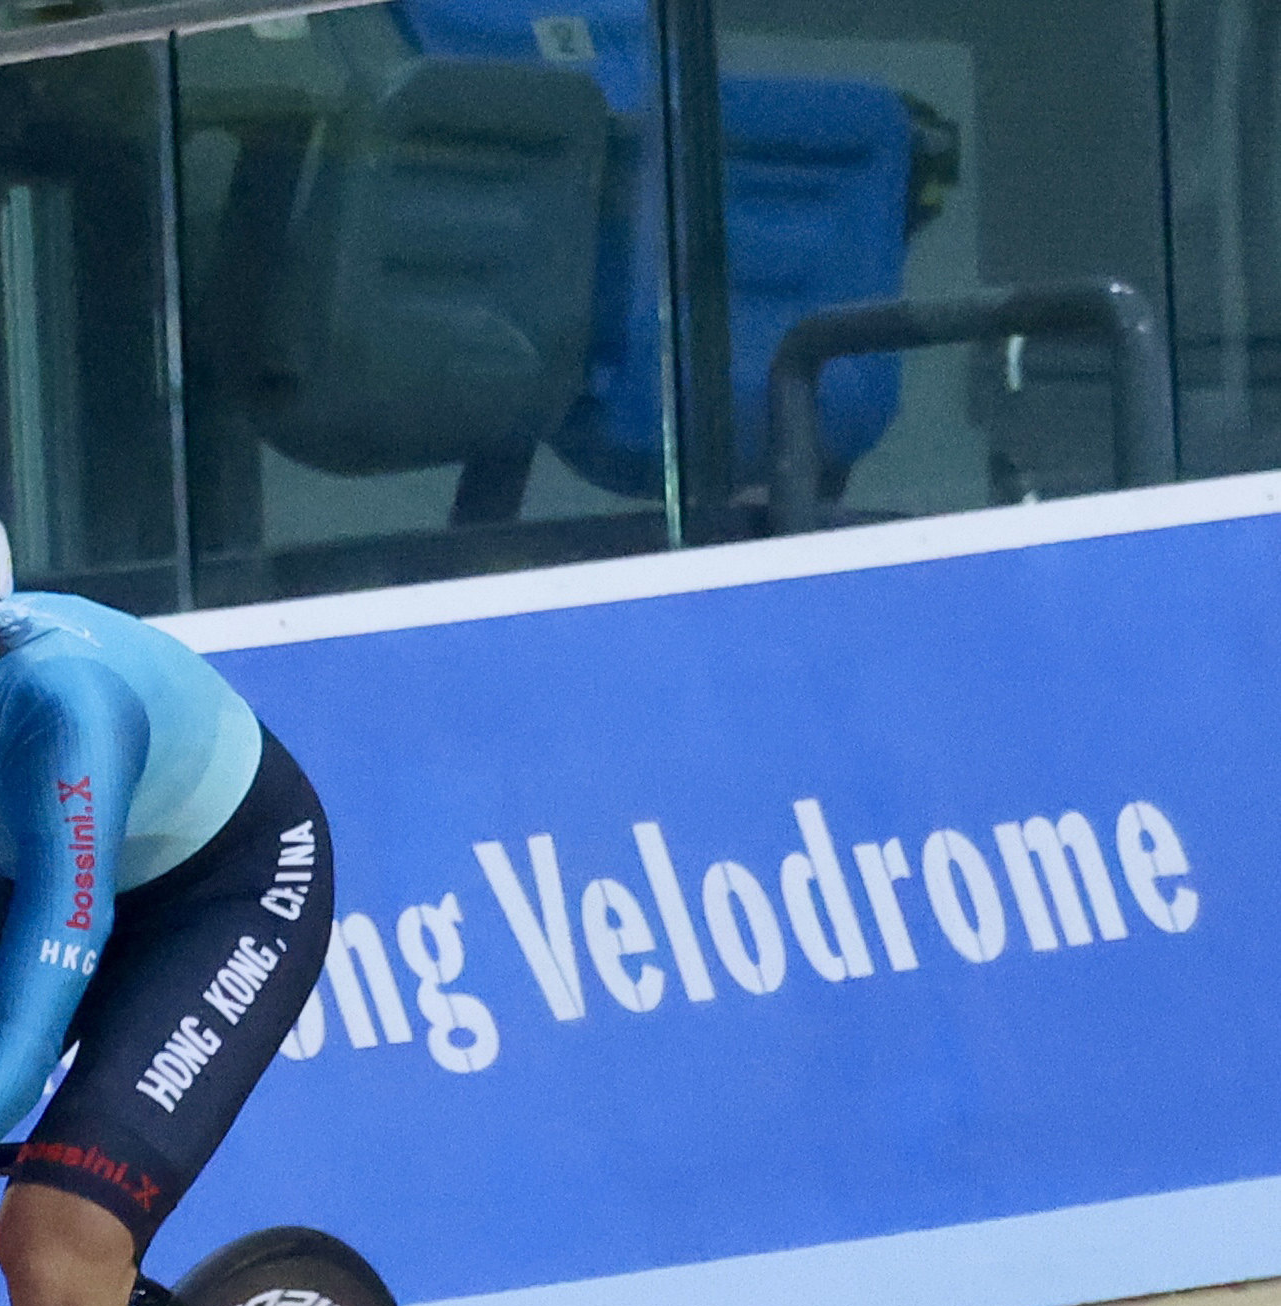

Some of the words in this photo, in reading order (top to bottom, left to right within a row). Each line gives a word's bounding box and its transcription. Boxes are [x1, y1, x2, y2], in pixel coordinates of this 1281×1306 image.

[39, 939, 98, 976] HKG
[57, 775, 96, 931] bossini.X
[279, 892, 501, 1074] ng
[471, 798, 1200, 1022] Velodrome
[135, 1015, 223, 1114] HONG
[202, 935, 288, 1026] KONG,
[259, 819, 316, 921] CHINA
